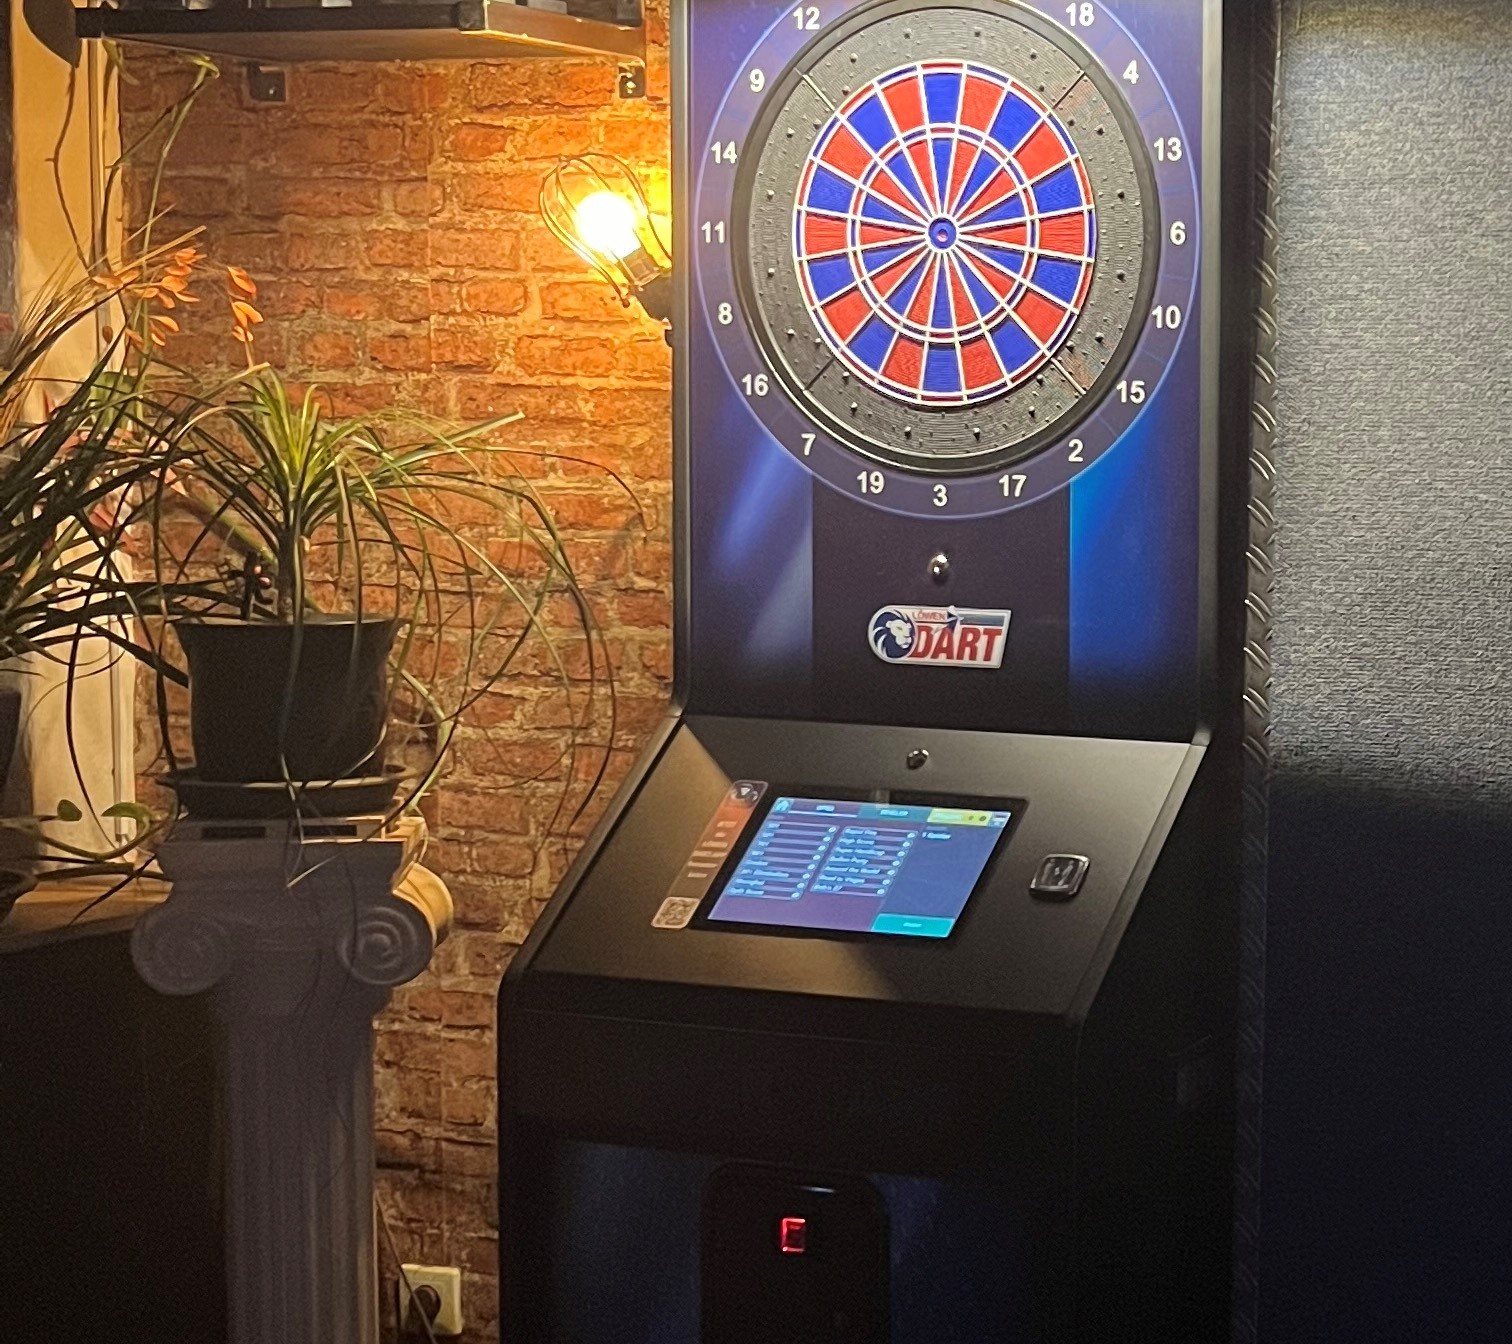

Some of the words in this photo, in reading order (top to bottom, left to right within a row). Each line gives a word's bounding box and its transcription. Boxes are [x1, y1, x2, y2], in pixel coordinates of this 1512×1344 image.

[792, 6, 821, 31] 12
[1064, 2, 1096, 27] 18
[749, 68, 766, 93] 9
[1122, 59, 1140, 85] 4
[710, 140, 738, 164] 14
[1153, 136, 1183, 162] 13
[701, 220, 725, 244] 11
[1170, 220, 1186, 246] 6
[717, 302, 733, 325] 8
[1151, 304, 1181, 329] 10
[741, 373, 770, 397] 16
[1115, 379, 1146, 404] 15
[801, 433, 816, 456] 7
[1068, 438, 1084, 462] 2
[856, 470, 885, 494] 19
[998, 474, 1027, 498] 17
[933, 484, 948, 507] 3
[908, 626, 1002, 662] DART
